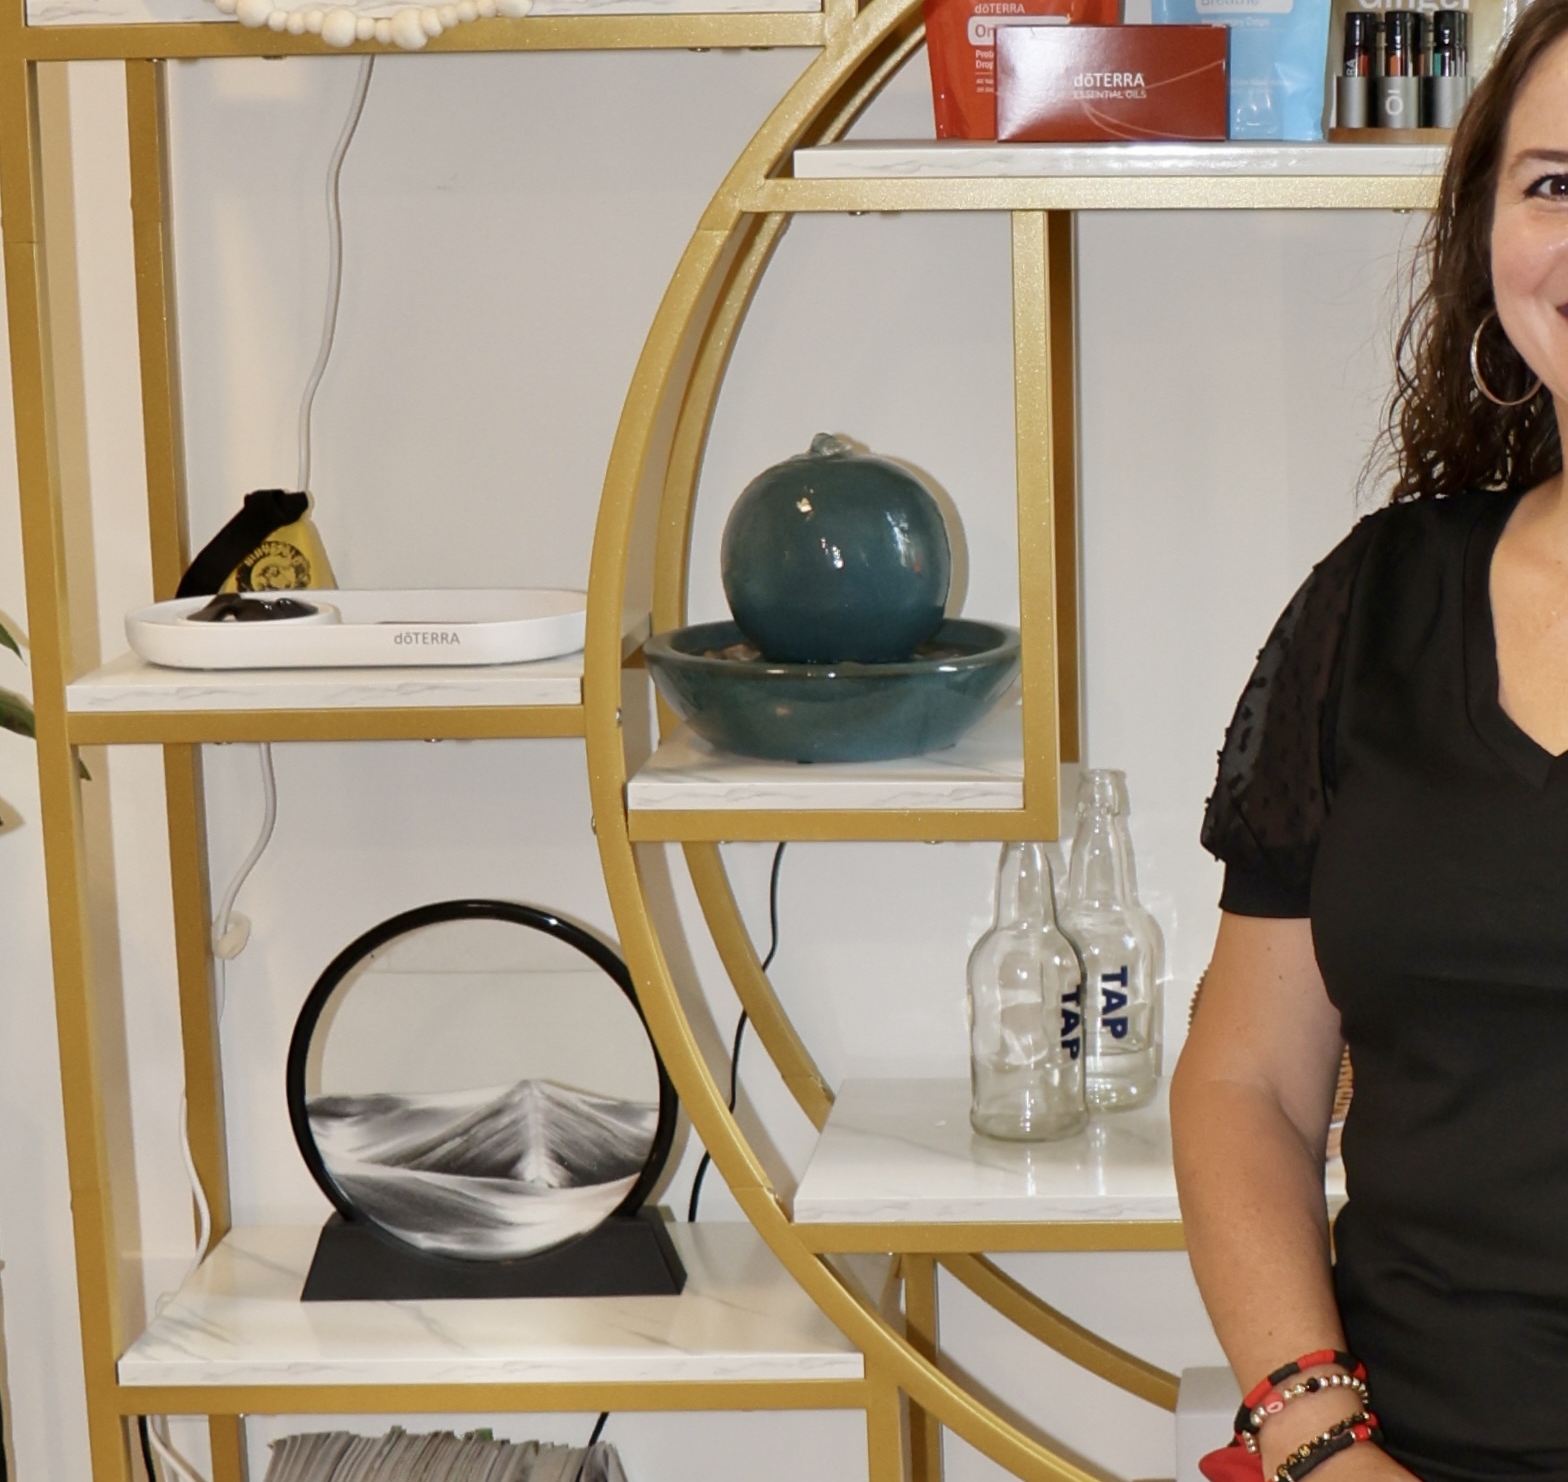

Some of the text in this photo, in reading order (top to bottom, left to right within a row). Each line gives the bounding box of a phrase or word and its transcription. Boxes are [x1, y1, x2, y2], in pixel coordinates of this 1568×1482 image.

[1074, 89, 1147, 99] ESSENTIAL OILS
[1060, 984, 1082, 1062] TAP
[1100, 965, 1129, 1041] TAP
